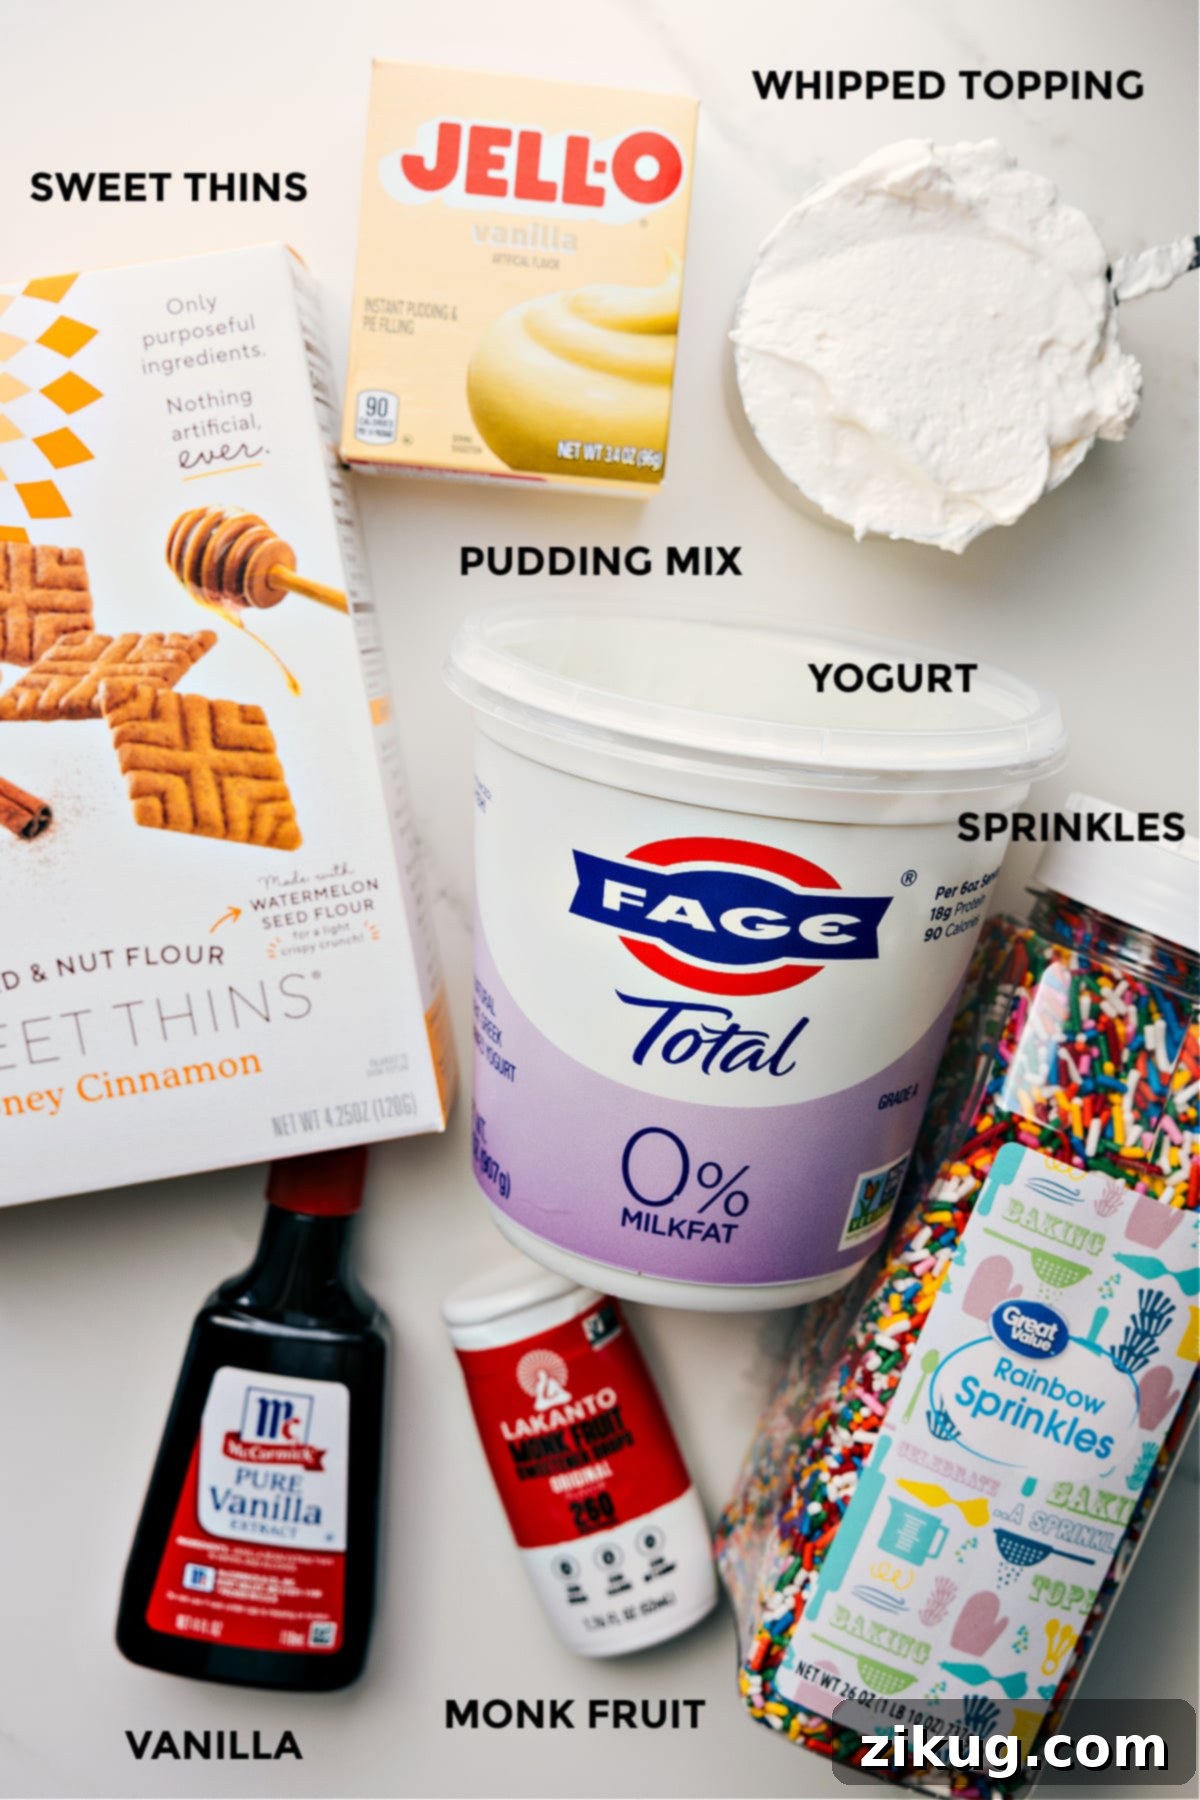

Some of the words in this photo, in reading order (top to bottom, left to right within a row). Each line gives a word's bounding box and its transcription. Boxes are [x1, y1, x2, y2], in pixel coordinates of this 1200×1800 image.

[472, 222, 579, 253] vanilla
[166, 294, 217, 315] Only
[364, 297, 405, 315] INSTANT
[142, 313, 256, 351] purposeful
[140, 344, 267, 376] ingredients.
[166, 389, 253, 415] Nothing
[365, 396, 389, 418] 90
[171, 412, 262, 442] artificial,
[178, 442, 271, 469] ever.
[557, 440, 581, 460] NET
[583, 443, 603, 461] WT
[249, 877, 379, 911] WATERMELON
[935, 885, 958, 900] Per
[261, 911, 308, 930] SEED
[314, 899, 375, 920] FLOUR
[602, 879, 862, 945] FAGE
[930, 906, 952, 921] 18g
[923, 926, 943, 942] 90
[0, 970, 20, 991] D
[30, 963, 47, 983] &
[56, 949, 114, 977] NUT
[126, 945, 225, 967] FLOUR
[112, 973, 312, 1047] THINS
[615, 989, 810, 1076] Total
[76, 1053, 262, 1102] Cinnamon
[271, 1112, 297, 1138] NET
[300, 1108, 320, 1132] WT
[621, 1126, 750, 1218] 0%
[621, 1207, 739, 1244] MILKFAT
[1001, 1197, 1106, 1257] BAKING
[1002, 1306, 1059, 1341] Great
[1011, 1326, 1053, 1352] Value
[993, 1356, 1106, 1415] Rainbow
[500, 1387, 617, 1441] LAKANTO
[955, 1376, 1115, 1460] Sprinkles
[235, 1467, 303, 1493] PURE
[209, 1485, 322, 1525] Vanilla
[828, 1603, 932, 1666] BAKING
[795, 1660, 818, 1682] NET
[820, 1672, 842, 1693] WT
[841, 1682, 857, 1701] 26
[858, 1690, 876, 1708] OZ
[875, 1695, 889, 1714] (1
[889, 1701, 905, 1720] LB
[907, 1709, 923, 1725] 10
